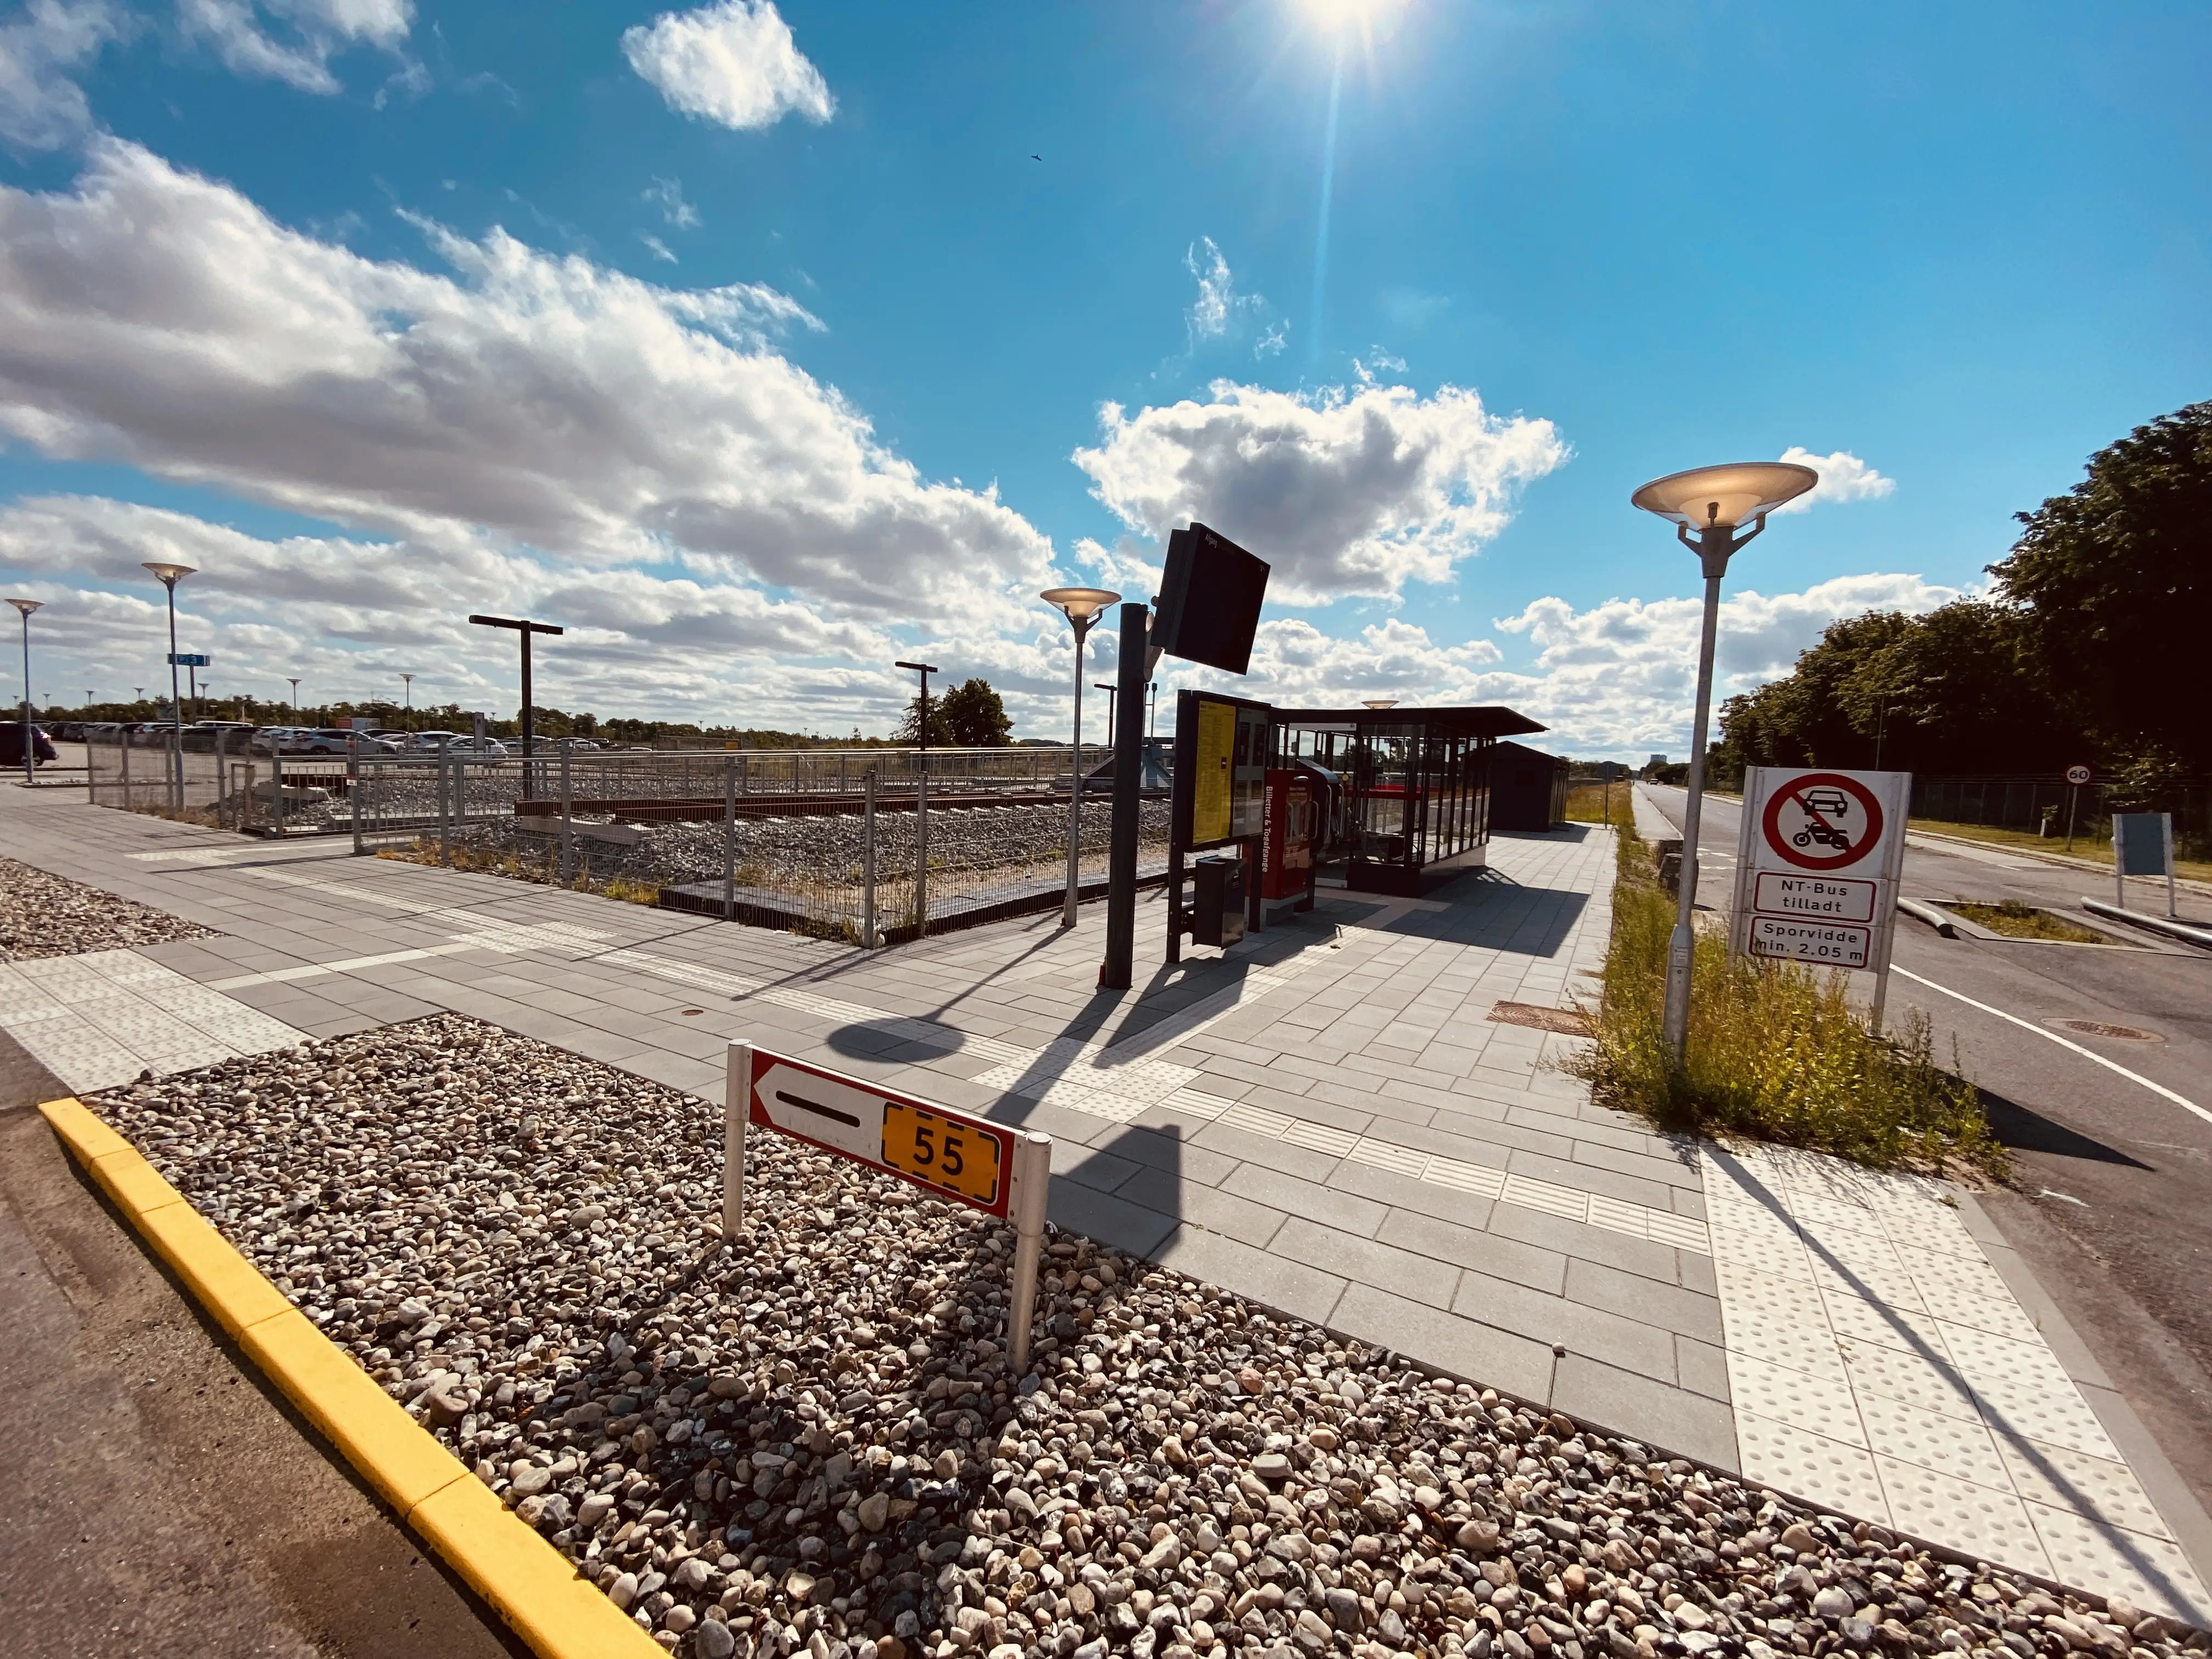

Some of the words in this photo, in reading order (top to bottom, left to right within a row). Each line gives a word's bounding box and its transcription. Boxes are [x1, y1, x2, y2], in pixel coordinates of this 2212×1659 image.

[2069, 770, 2088, 779] 60
[1265, 786, 1273, 819] Billetter
[1262, 827, 1271, 873] Togafgange
[1781, 880, 1848, 896] NT-Bus
[1782, 897, 1842, 912] tilladt
[1764, 923, 1858, 943] Sporvidde
[1754, 939, 1790, 953] min.
[1798, 943, 1841, 958] 2.05
[1849, 951, 1862, 961] m
[913, 1126, 963, 1176] 55
